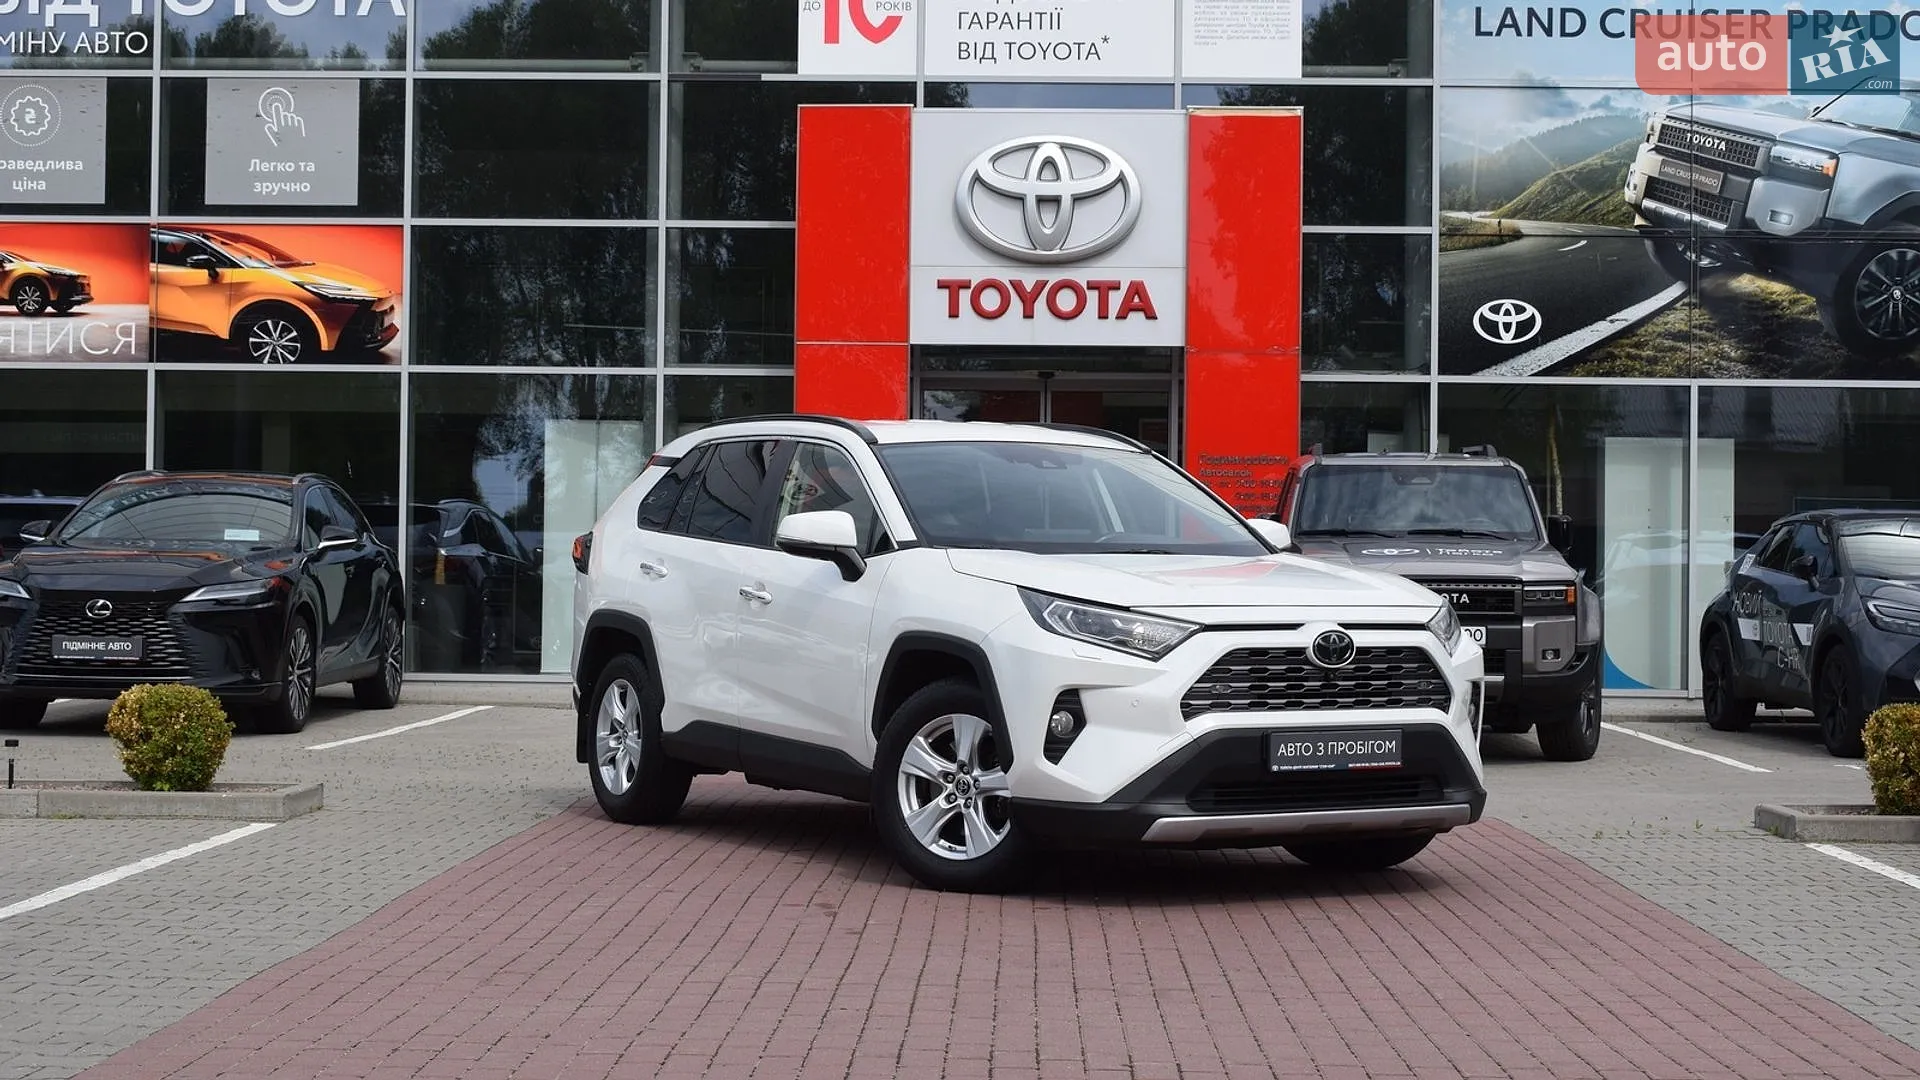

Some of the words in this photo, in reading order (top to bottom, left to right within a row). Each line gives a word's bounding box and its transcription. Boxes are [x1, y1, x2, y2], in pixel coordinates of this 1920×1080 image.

[875, 1, 912, 11] РОКІВ
[957, 7, 1063, 30] ГАРАНТІЇ
[1474, 7, 1587, 38] LAND
[1599, 8, 1772, 40] CRUISER
[73, 31, 149, 54] АВТО
[957, 41, 997, 64] ВІД
[248, 159, 294, 173] Легко
[298, 161, 316, 173] та
[12, 177, 46, 192] ціна
[253, 180, 311, 195] зручно
[937, 278, 1158, 320] TOYOTA
[62, 641, 106, 651] ПІДМІННЕ
[108, 642, 132, 651] АВТО
[1277, 742, 1313, 757] АВТО
[1328, 740, 1396, 755] ПРОБІГОМ
